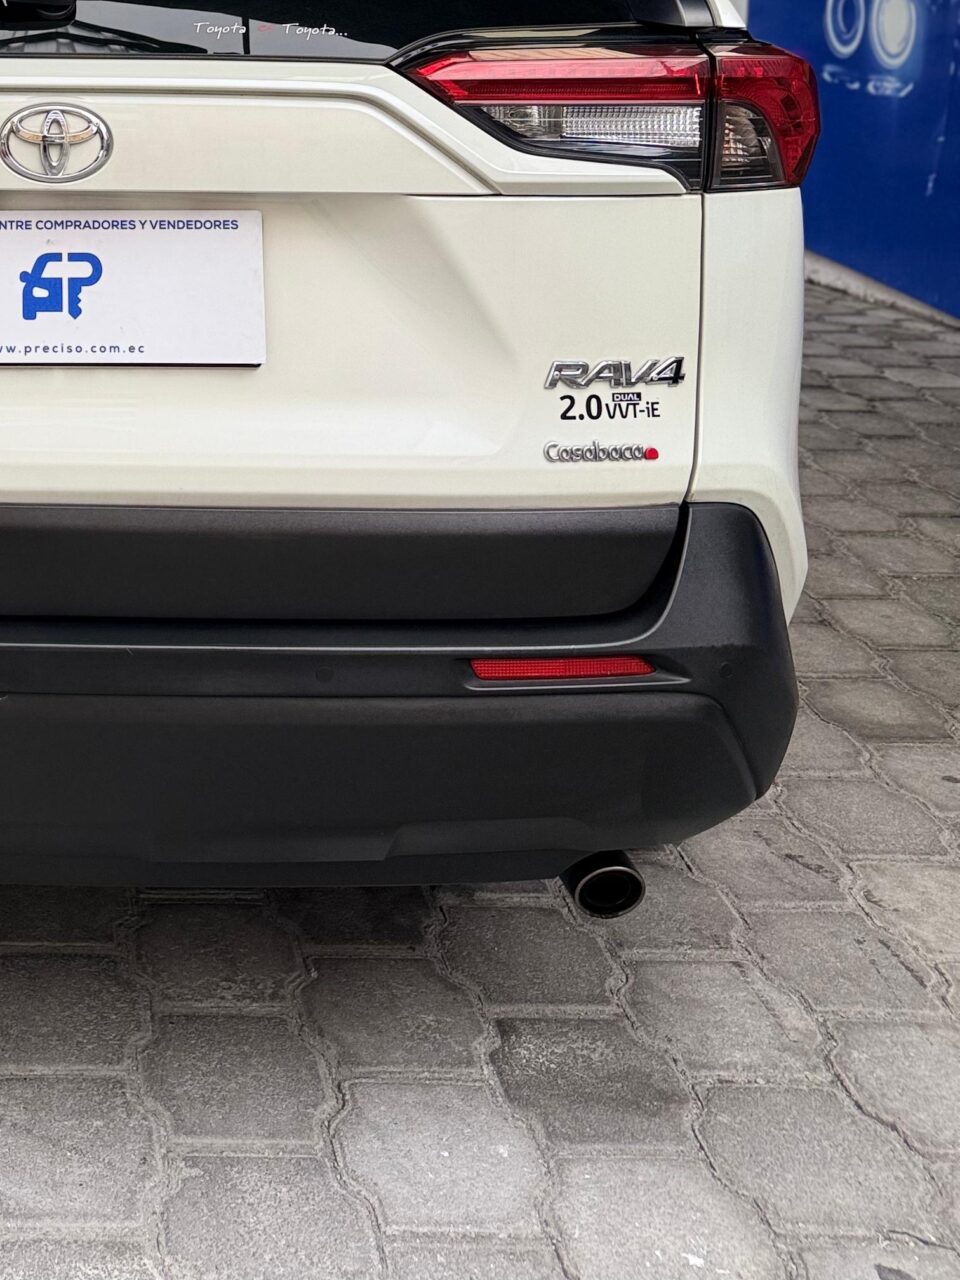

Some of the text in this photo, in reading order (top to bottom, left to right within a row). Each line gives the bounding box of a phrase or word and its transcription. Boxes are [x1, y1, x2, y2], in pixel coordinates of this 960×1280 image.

[194, 22, 246, 39] Toyota
[35, 220, 136, 230] COMPRADORES
[139, 220, 147, 230] Y
[149, 220, 239, 230] VENDEDORES
[544, 356, 686, 389] RAV4
[559, 394, 603, 420] 2.0
[612, 393, 641, 402] DUAL
[543, 439, 644, 463] Casabaca
